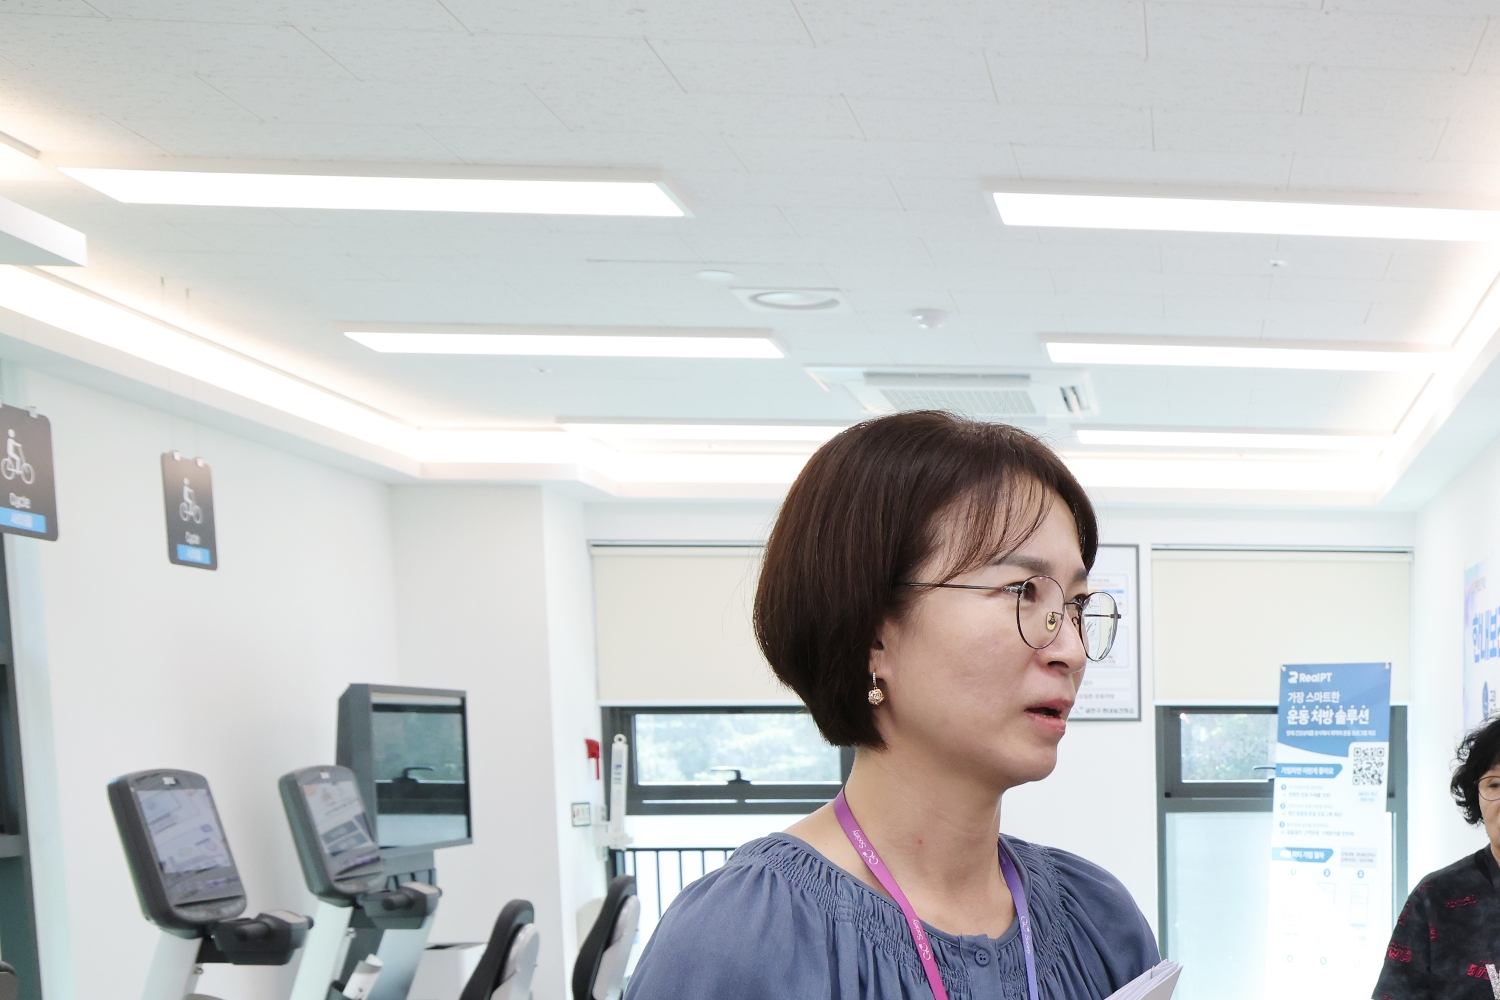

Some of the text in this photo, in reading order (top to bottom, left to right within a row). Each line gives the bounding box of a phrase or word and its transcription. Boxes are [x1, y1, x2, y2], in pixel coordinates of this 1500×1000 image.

[1287, 691, 1340, 703] 가장 스마트한
[1287, 707, 1370, 725] 운동 처방 솔루션
[851, 829, 867, 849] Society
[911, 918, 924, 941] Society
